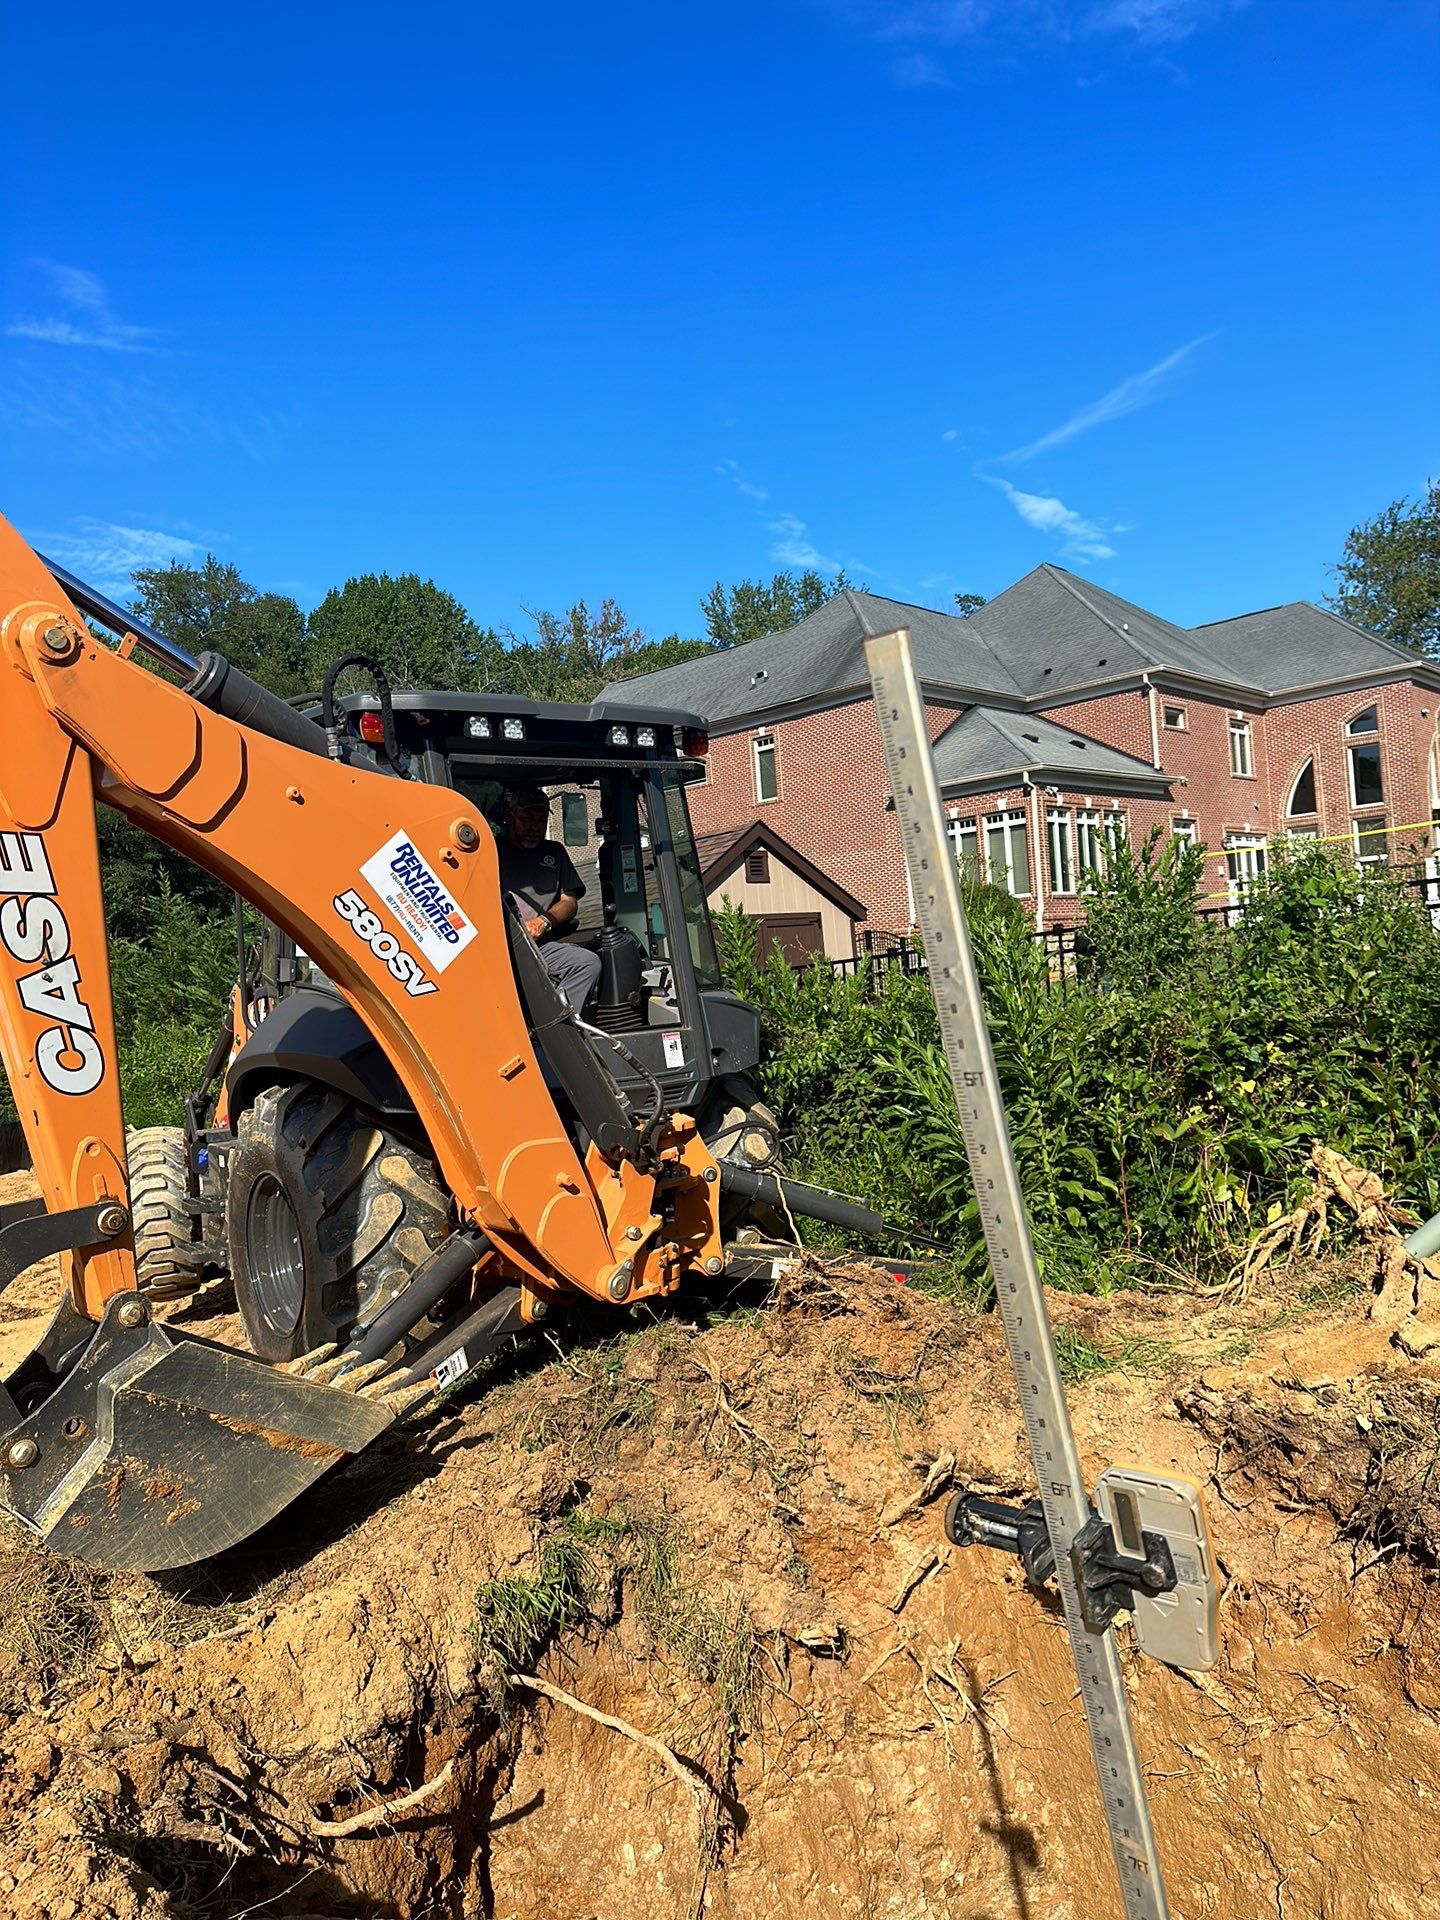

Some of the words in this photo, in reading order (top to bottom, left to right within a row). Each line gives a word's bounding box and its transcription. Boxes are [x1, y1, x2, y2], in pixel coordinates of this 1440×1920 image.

[892, 709, 899, 721] 2
[908, 786, 913, 796] 4
[913, 823, 921, 833] 5
[921, 859, 928, 870] 6
[396, 843, 454, 915] RENTALS
[390, 857, 460, 944] UNLIMITED
[390, 871, 412, 898] EQUIPMENT
[410, 898, 419, 909] AND
[418, 908, 431, 924] TRUCK
[429, 923, 443, 940] RENTAL
[928, 896, 934, 906] 7
[395, 892, 407, 904] RU
[404, 903, 427, 932] READY!
[935, 932, 942, 942] 8
[333, 888, 440, 997] 580SV
[0, 832, 105, 1096] CASE
[943, 968, 950, 978] 9
[973, 1110, 978, 1119] 1
[980, 1144, 986, 1155] 2
[986, 1179, 994, 1189] 3
[995, 1214, 1001, 1224] 4
[1002, 1248, 1009, 1258] 5
[1009, 1283, 1016, 1293] 6
[1016, 1317, 1022, 1326] 7
[1024, 1351, 1030, 1361] 8
[1032, 1384, 1038, 1394] 9
[1060, 1516, 1065, 1526] 1
[1085, 1644, 1092, 1653] 5
[1092, 1675, 1098, 1684] 6
[1098, 1706, 1104, 1715] 7
[1104, 1737, 1112, 1747] 8
[1111, 1768, 1118, 1778] 9
[1136, 1888, 1142, 1898] 1
